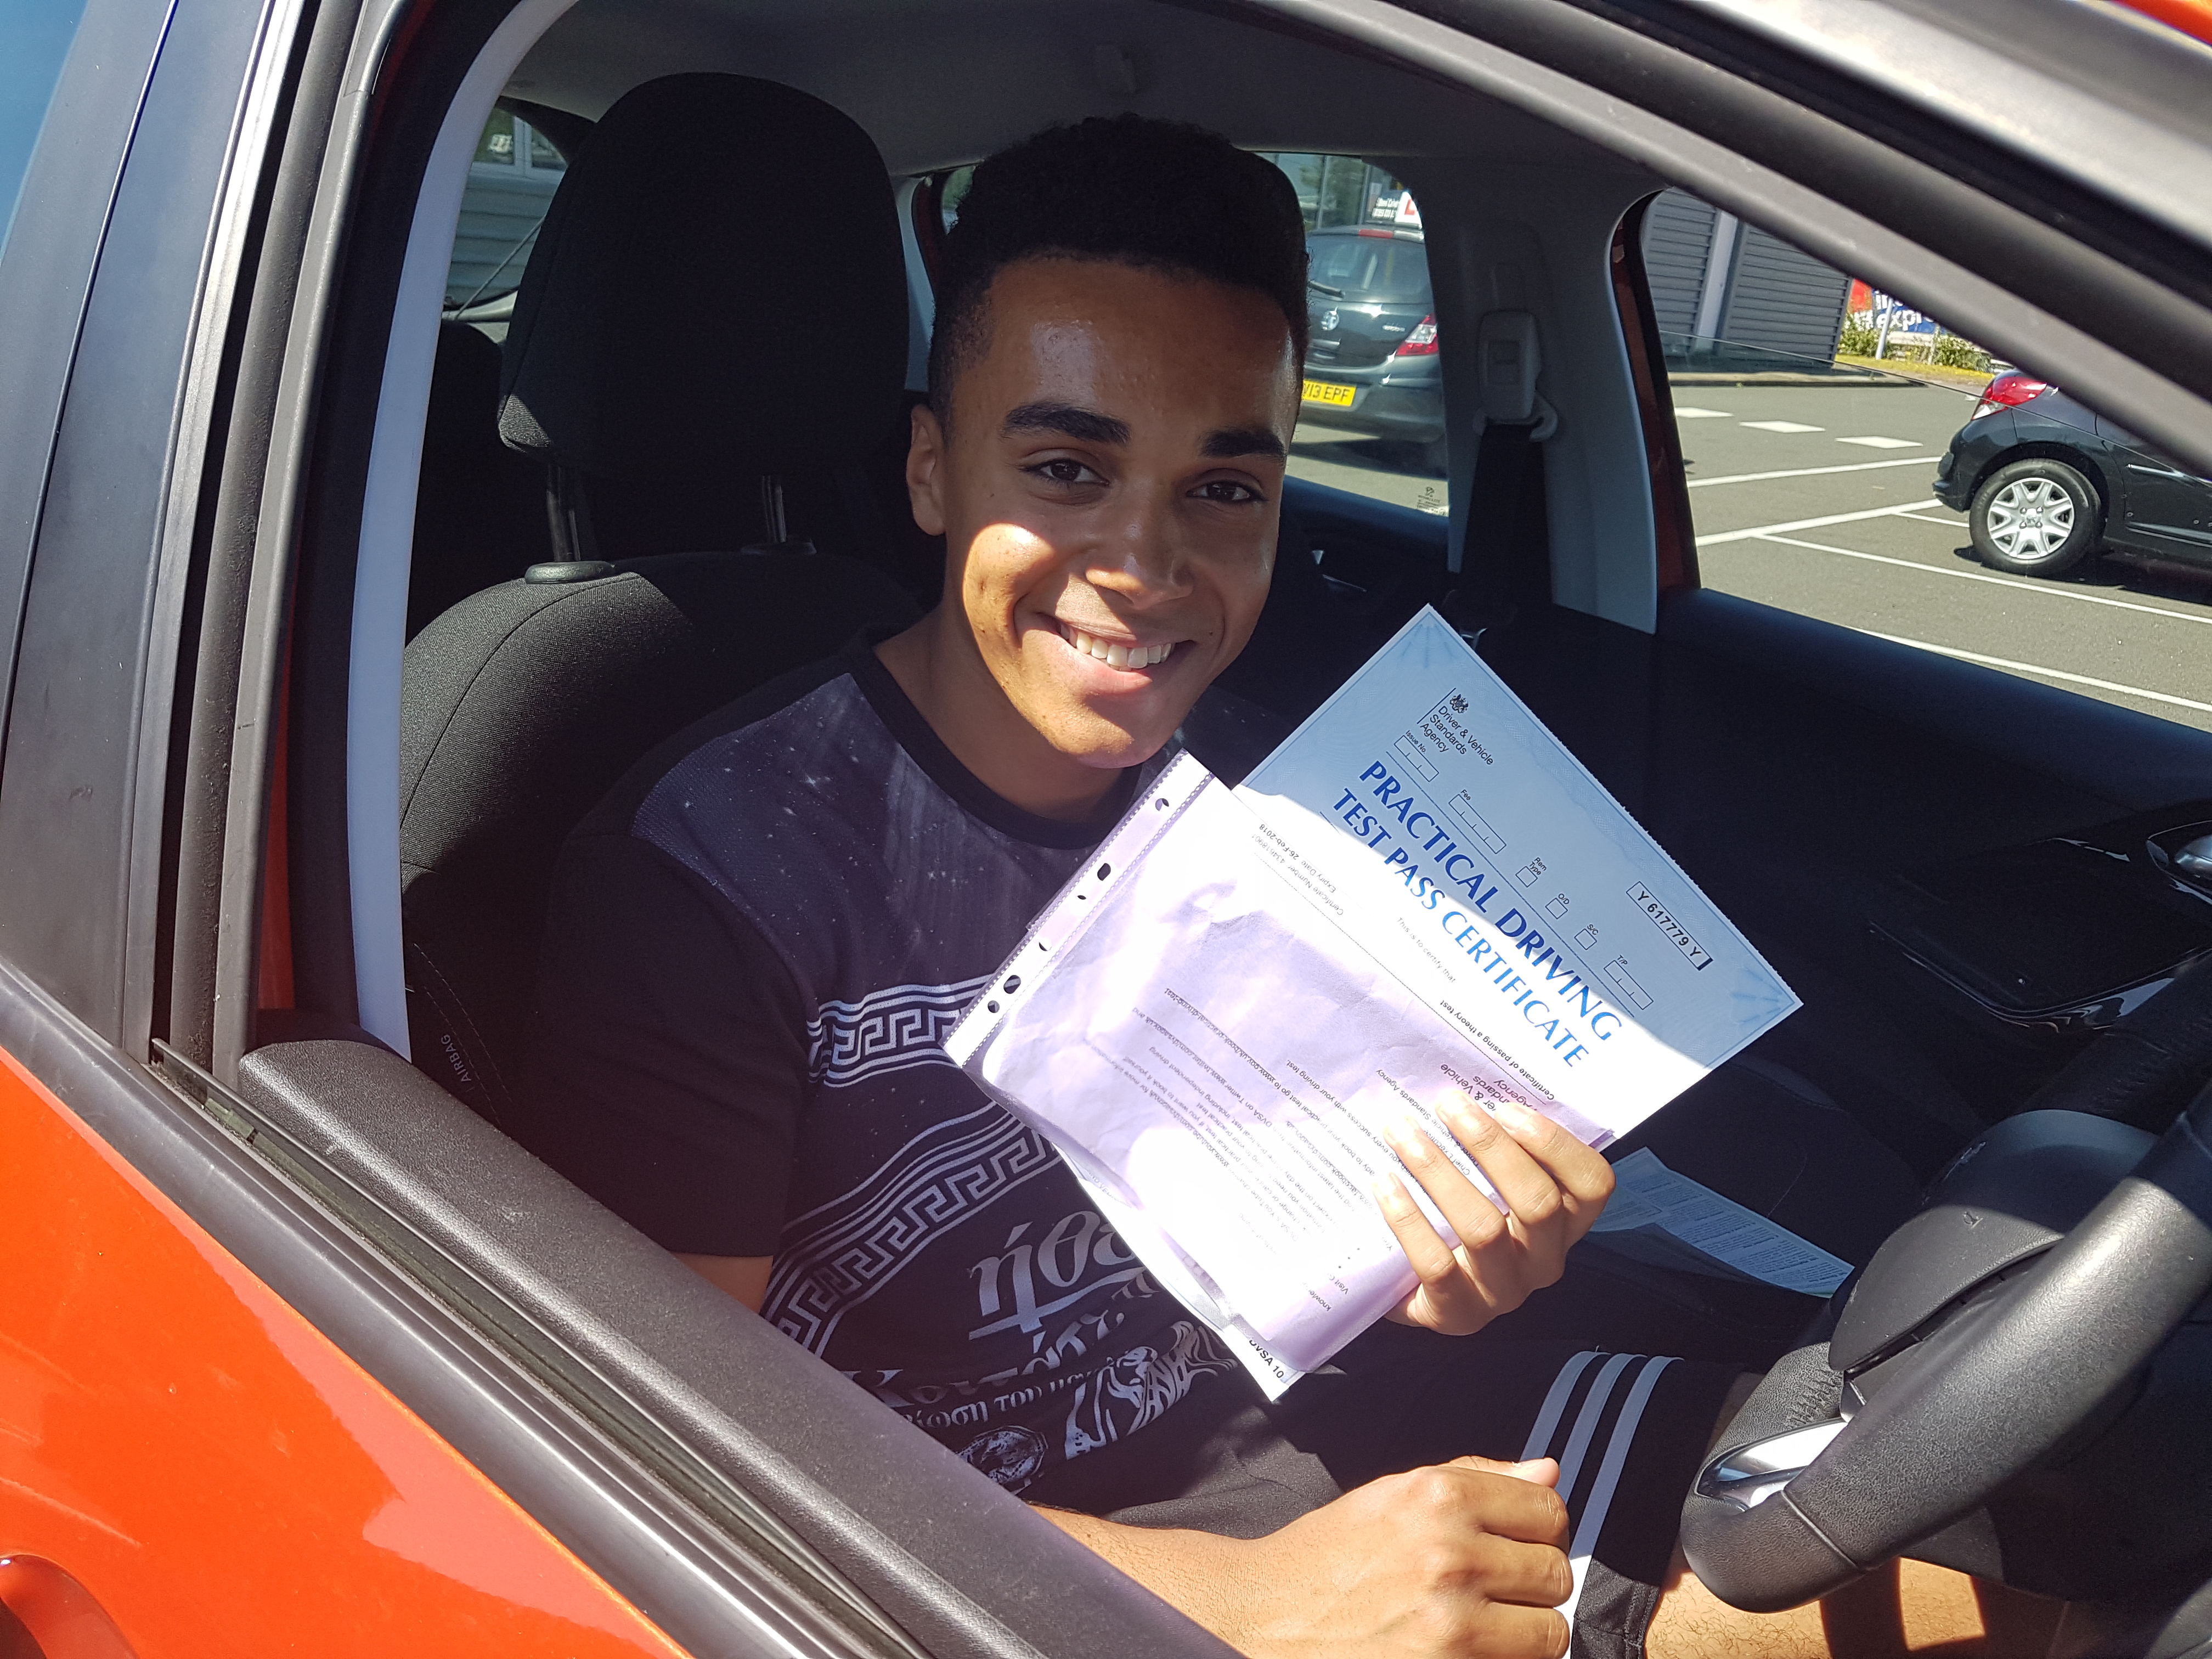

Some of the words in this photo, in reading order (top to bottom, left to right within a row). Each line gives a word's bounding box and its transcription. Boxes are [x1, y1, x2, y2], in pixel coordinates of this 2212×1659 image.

[1323, 386, 1350, 402] EPF
[1404, 729, 1420, 745] Issue
[1417, 743, 1428, 754] No.
[1418, 721, 1451, 755] Agency
[1428, 713, 1469, 755] Standards
[1437, 704, 1463, 732] Driver
[1458, 727, 1470, 739] &
[1465, 734, 1496, 766] Vehicle
[1460, 788, 1472, 801] Fee
[1257, 822, 1300, 861] 26-Feb-2018
[1299, 859, 1317, 876] Date
[1527, 861, 1543, 877] Type
[1533, 856, 1548, 872] Rem
[1285, 863, 1313, 889] Number
[1314, 872, 1337, 894] Expiry
[1311, 885, 1345, 916] Certificate
[1357, 759, 1504, 914] PRACTICAL
[1493, 906, 1624, 1043] DRIVING
[1556, 891, 1571, 906] O/D
[1328, 787, 1392, 853] TEST
[1381, 845, 1447, 913] PASS
[1436, 905, 1591, 1069] CERTIFICATE
[1585, 923, 1599, 936] S/C
[1635, 890, 1650, 904] Y
[1646, 901, 1690, 948] 617779
[1687, 945, 1702, 960] Y
[1394, 916, 1412, 934] This
[1414, 938, 1425, 949] to
[1420, 945, 1445, 970] certify
[1441, 967, 1458, 984] that
[1616, 954, 1628, 967] T/P
[1131, 1006, 1146, 1020] and
[1438, 998, 1455, 1014] test
[1452, 1009, 1478, 1034] theory
[1147, 1045, 1171, 1067] driving
[1481, 1034, 1512, 1063] passing
[440, 1034, 472, 1084] AIRBAG
[1284, 1058, 1300, 1074] test.
[1508, 1059, 1520, 1070] of
[1150, 1077, 1169, 1095] book
[1167, 1062, 1206, 1098] independent
[1272, 1080, 1282, 1090] to
[1297, 1069, 1322, 1092] driving
[1374, 1066, 1402, 1092] Agency
[1438, 1061, 1475, 1095] Vehicle
[1517, 1066, 1556, 1102] Certificate
[1222, 1082, 1246, 1104] Twitter
[1279, 1086, 1291, 1097] go
[1288, 1093, 1303, 1108] test
[1318, 1086, 1336, 1103] your
[1471, 1073, 1510, 1109] ndards
[1172, 1096, 1190, 1114] want
[1202, 1092, 1232, 1121] including
[1243, 1101, 1254, 1111] on
[1331, 1099, 1348, 1115] with
[1397, 1088, 1432, 1121] Standards
[1186, 1109, 1201, 1124] you
[1205, 1111, 1234, 1138] practical
[1251, 1108, 1273, 1128] DVSA
[1300, 1103, 1328, 1131] practical
[1345, 1111, 1373, 1138] success
[1325, 1127, 1342, 1143] your
[1429, 1117, 1455, 1142] Vehicle
[1214, 1136, 1243, 1163] practical
[1230, 1135, 1246, 1150] your
[1339, 1141, 1357, 1158] book
[1370, 1134, 1390, 1153] every
[1243, 1148, 1252, 1158] to
[1284, 1139, 1319, 1173] information
[1354, 1155, 1364, 1165] to
[1271, 1176, 1289, 1194] need
[1282, 1169, 1297, 1184] day
[1315, 1171, 1335, 1190] latest
[1293, 1181, 1306, 1194] the
[1303, 1190, 1314, 1202] on
[1331, 1187, 1345, 1200] the
[1248, 1188, 1277, 1218] YouTube
[1270, 1193, 1280, 1203] or
[1286, 1191, 1300, 1205] you
[1277, 1199, 1302, 1225] change
[1311, 1199, 1335, 1222] expect
[1333, 1278, 1350, 1295] Visit
[1270, 1364, 1286, 1379] 10
